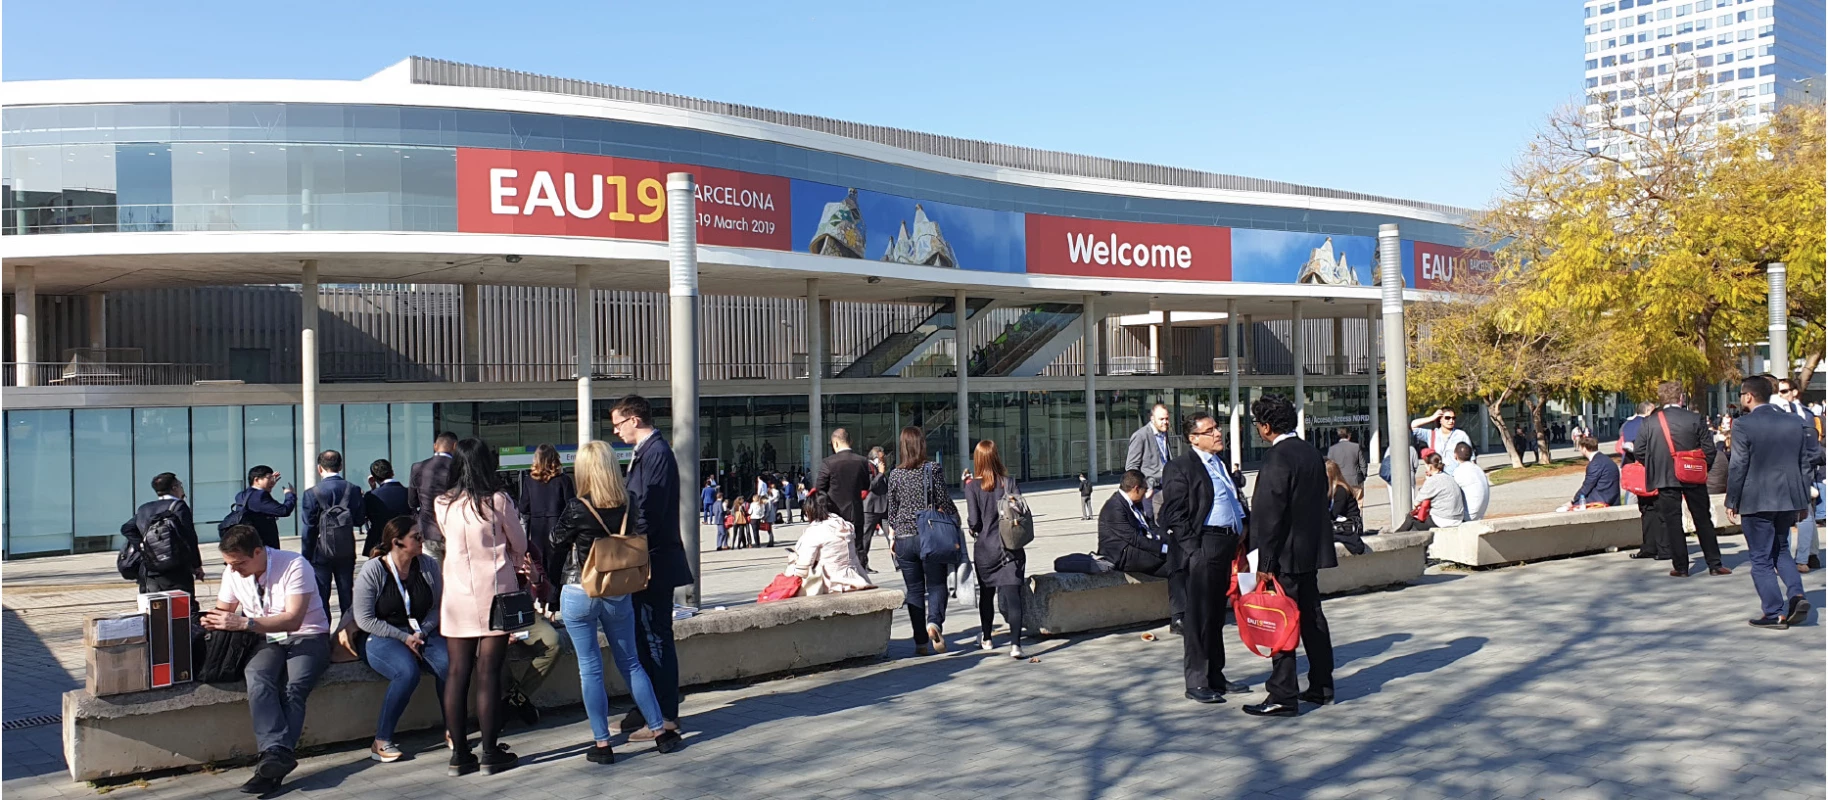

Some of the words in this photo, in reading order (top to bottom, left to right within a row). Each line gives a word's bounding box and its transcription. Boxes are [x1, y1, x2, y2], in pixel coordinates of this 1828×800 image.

[490, 168, 666, 224] EAU19
[694, 184, 775, 211] ARCELONA
[695, 212, 711, 227] -19
[713, 215, 749, 231] March
[752, 220, 775, 234] 2019
[1067, 232, 1192, 269] Welcome
[1352, 414, 1370, 422] NORD
